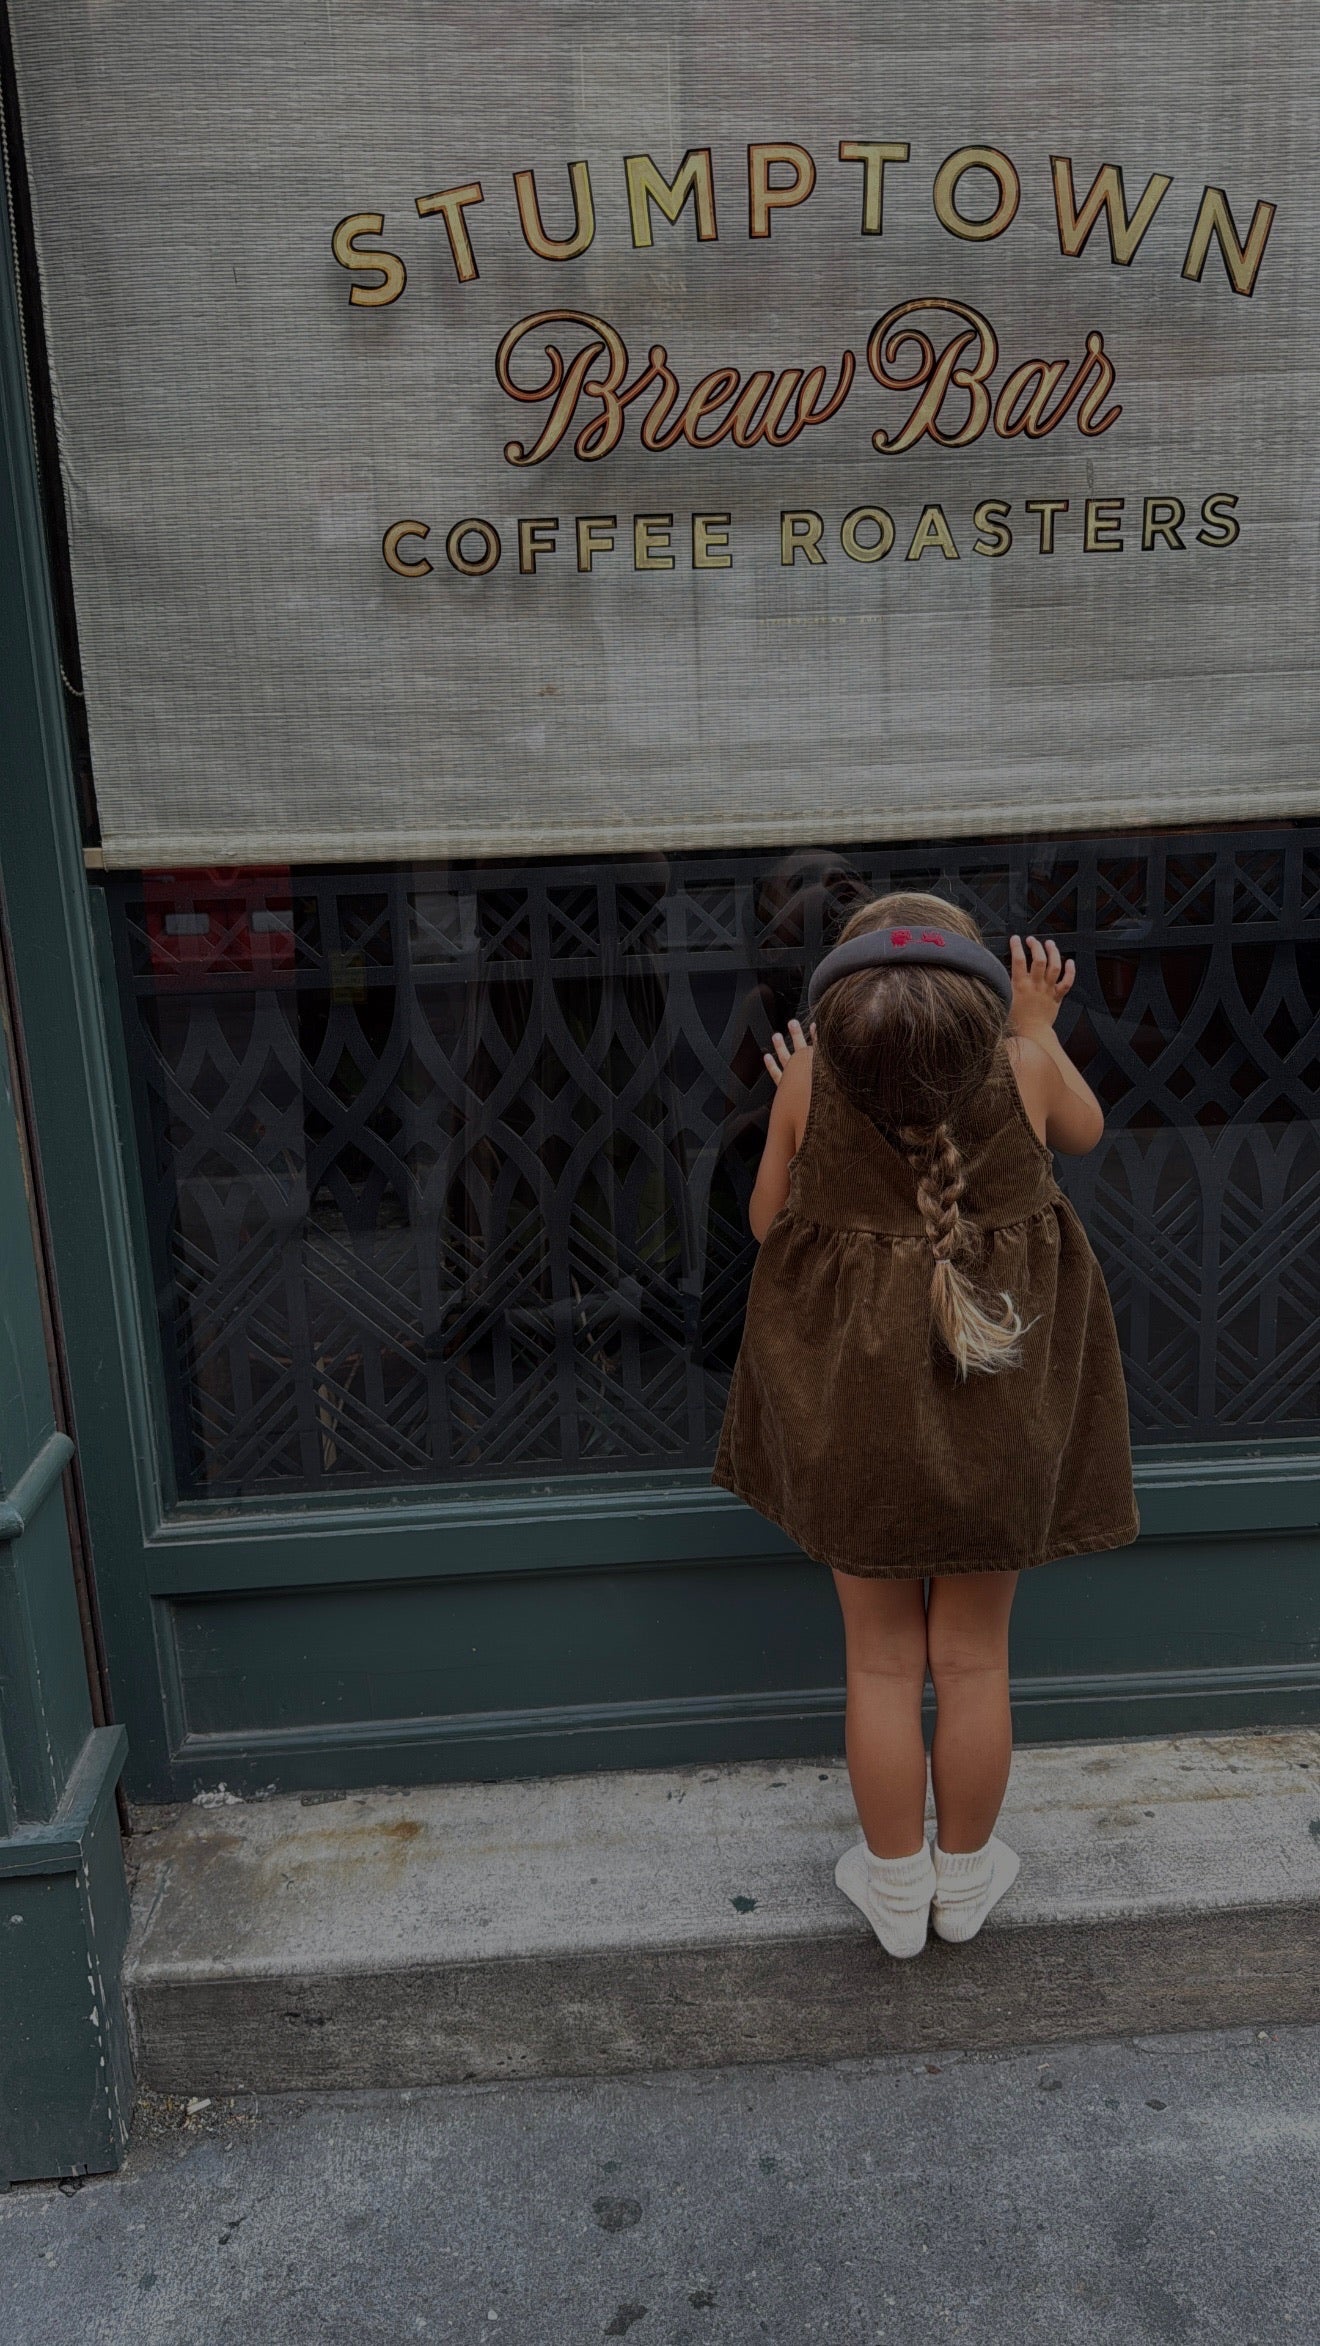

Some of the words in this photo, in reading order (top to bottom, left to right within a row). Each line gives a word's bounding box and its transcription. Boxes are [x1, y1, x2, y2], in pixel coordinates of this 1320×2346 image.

[331, 140, 1278, 308] STUMPTOWN
[494, 309, 855, 467] Brew
[867, 297, 1122, 455] Bar
[382, 513, 733, 577] COFFEE
[780, 493, 1241, 567] ROASTERS
